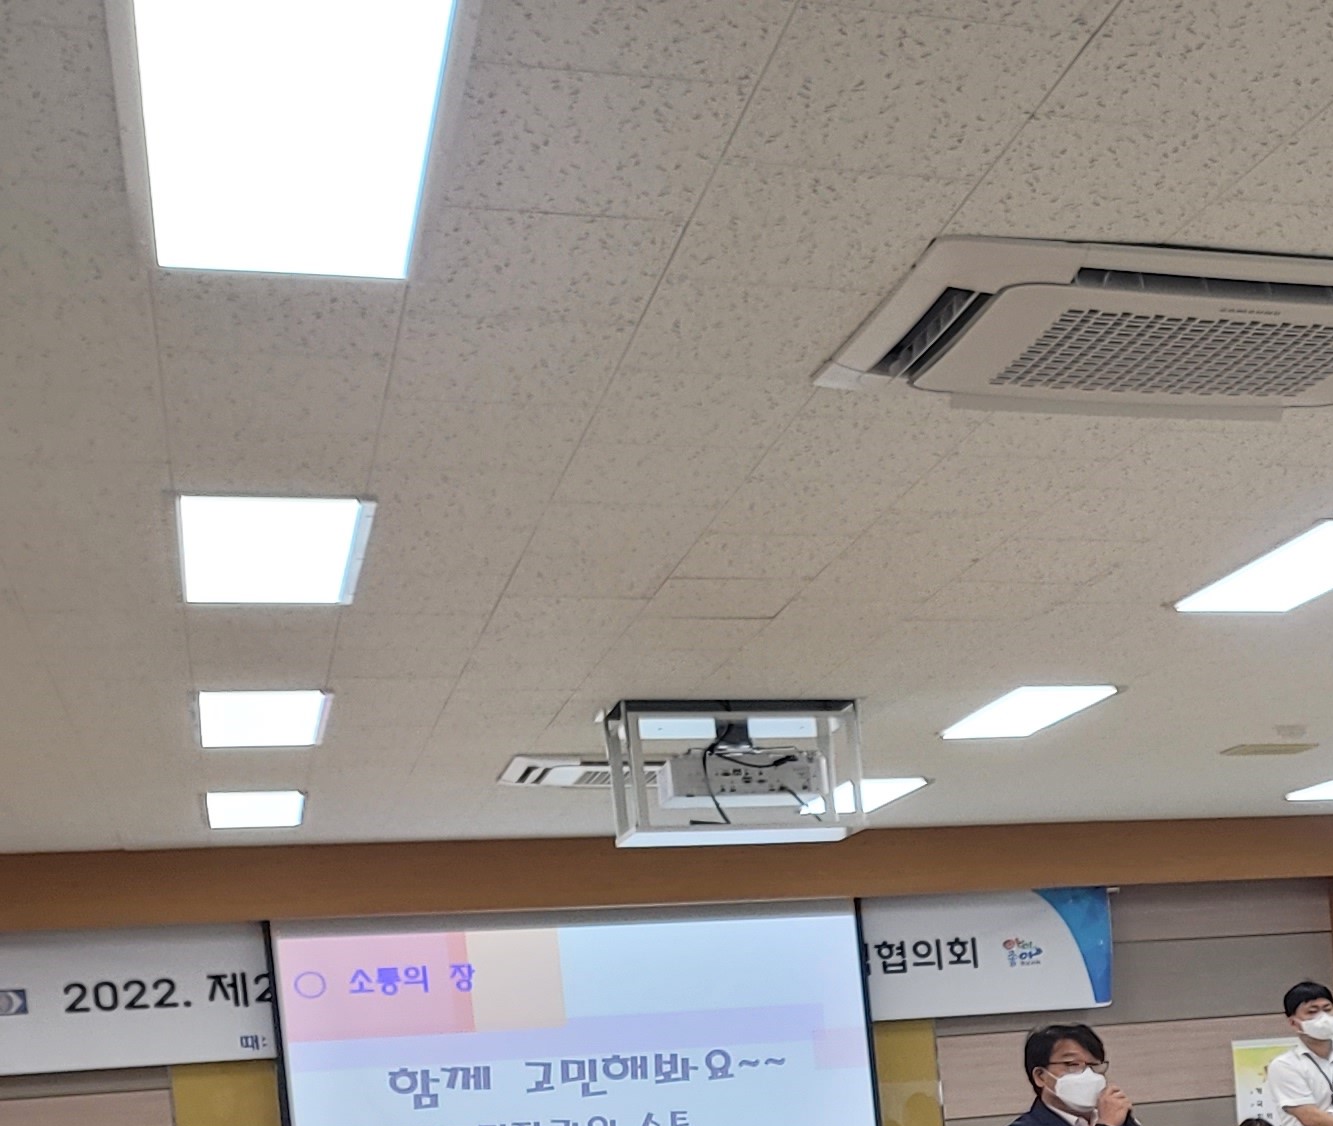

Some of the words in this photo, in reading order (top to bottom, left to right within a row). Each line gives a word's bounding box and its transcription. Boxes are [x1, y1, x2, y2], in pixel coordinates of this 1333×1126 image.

[63, 978, 192, 1013] 2022.
[349, 965, 429, 996] 소통의
[450, 963, 475, 993] 장
[388, 1065, 492, 1110] 함께
